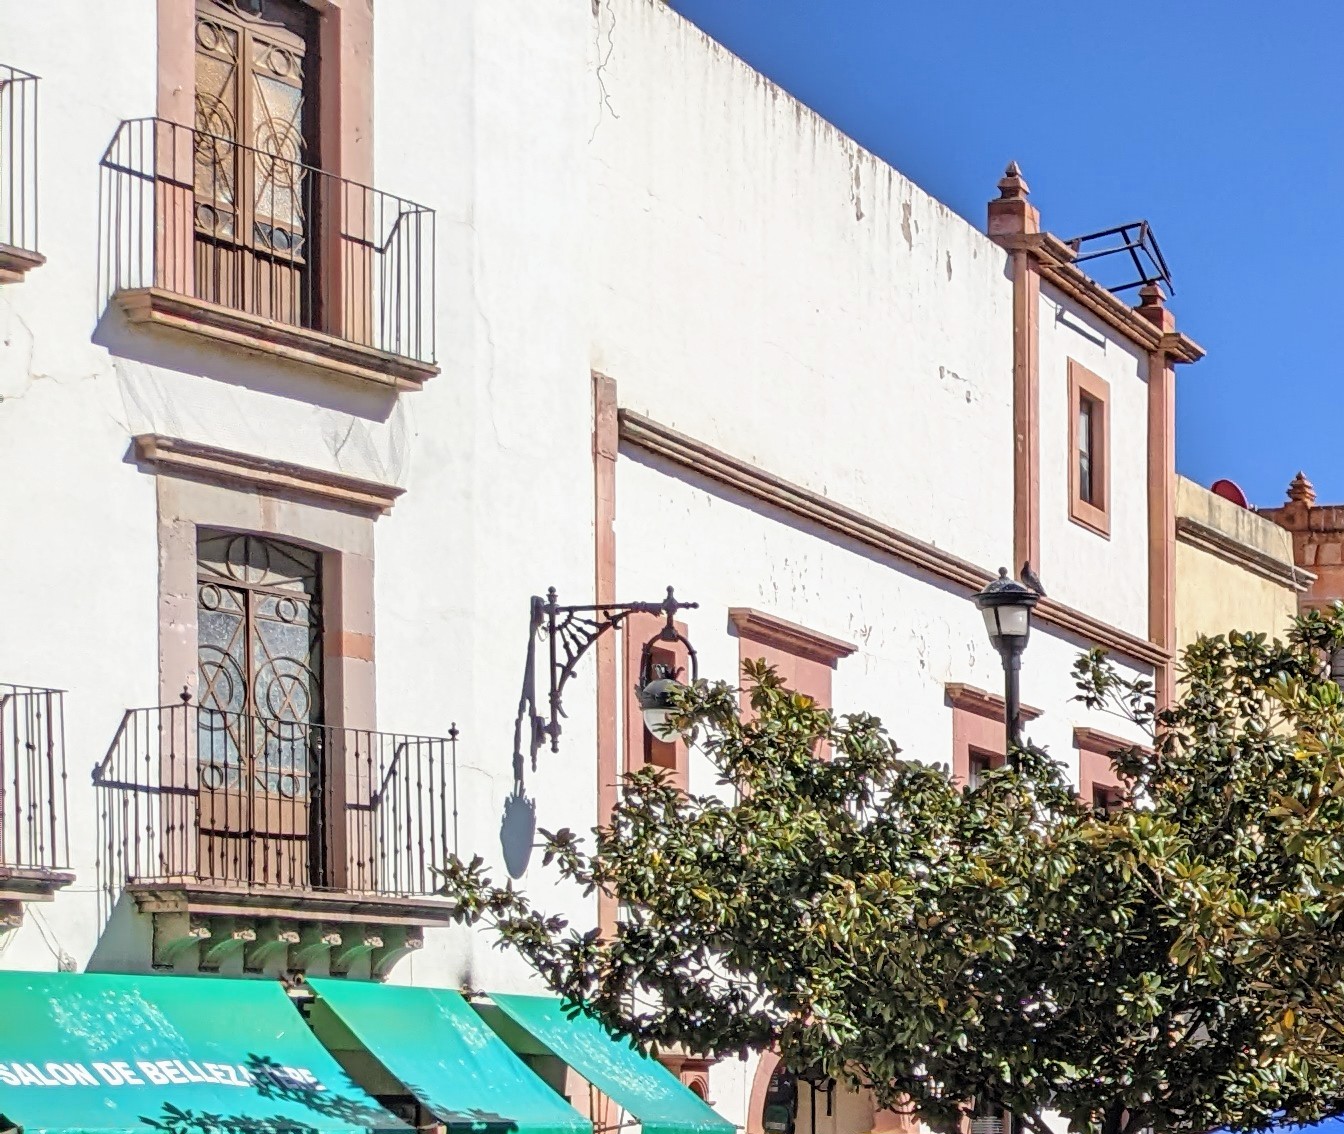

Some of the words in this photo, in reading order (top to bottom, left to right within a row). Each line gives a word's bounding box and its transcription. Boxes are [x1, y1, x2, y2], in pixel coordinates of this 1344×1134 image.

[0, 1062, 100, 1086] SALON
[91, 1061, 146, 1085] DE
[136, 1060, 267, 1089] BELLEZA
